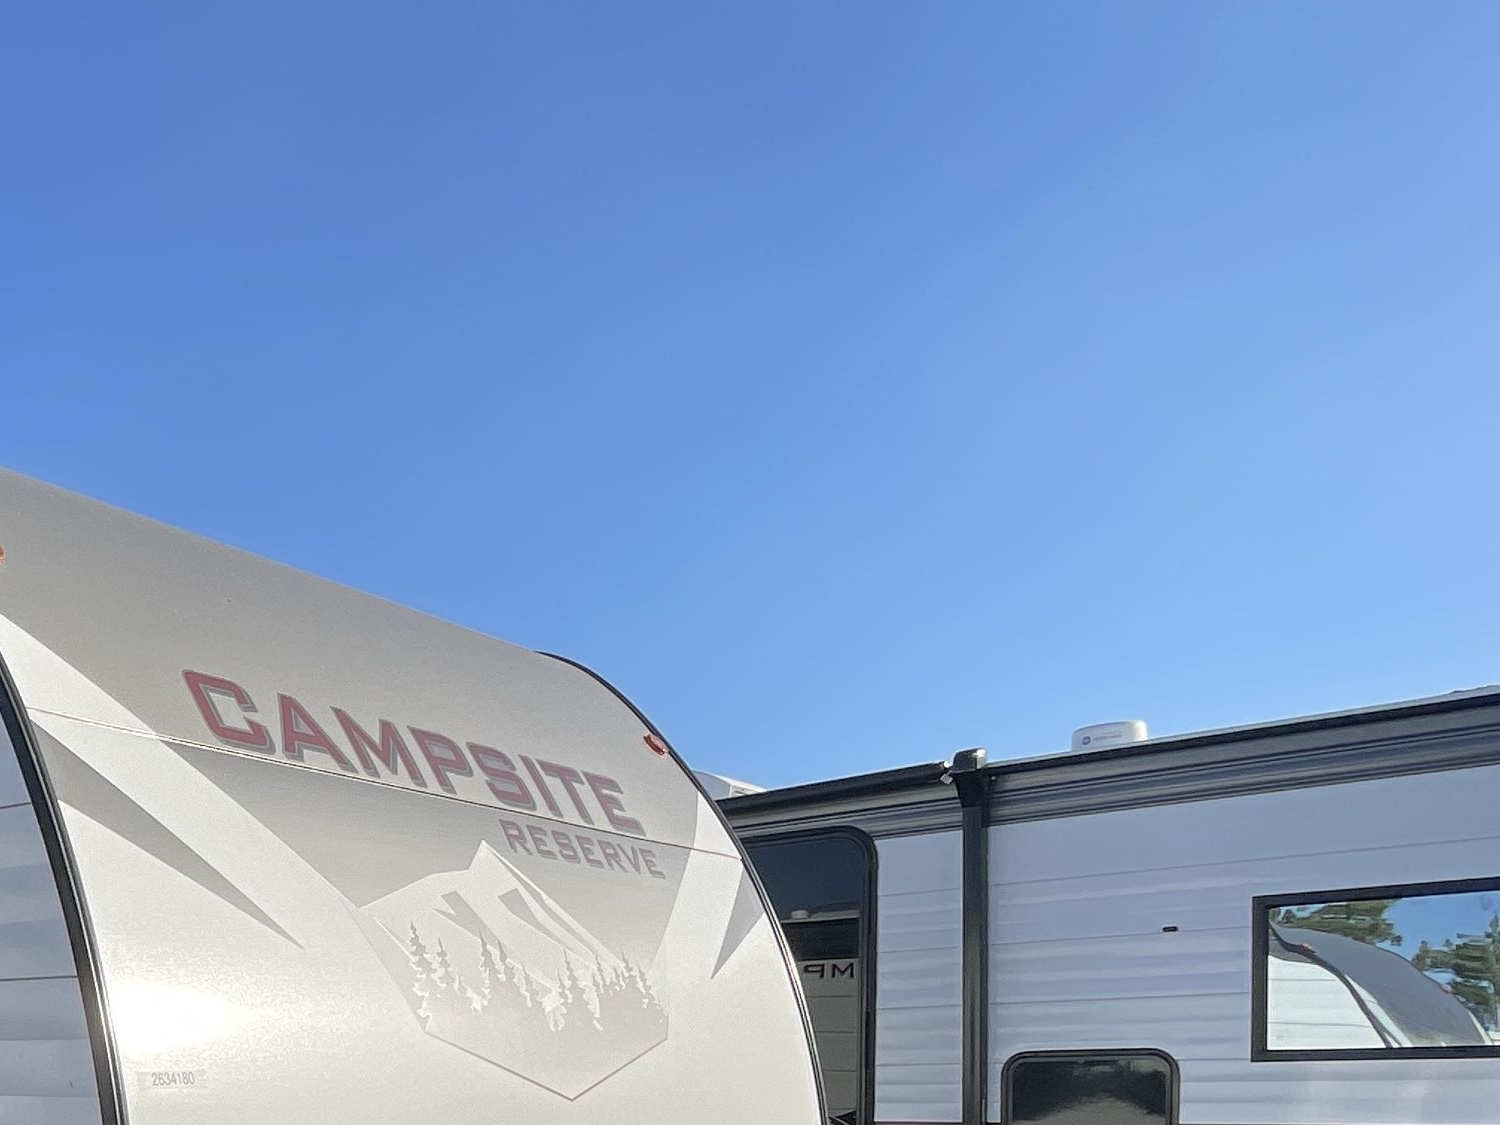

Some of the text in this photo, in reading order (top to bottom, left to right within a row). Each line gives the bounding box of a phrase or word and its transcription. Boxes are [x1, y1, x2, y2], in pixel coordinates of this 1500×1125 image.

[181, 668, 647, 837] CAMPSITE
[499, 818, 666, 879] RESERVE
[151, 1071, 195, 1086] 2634180
